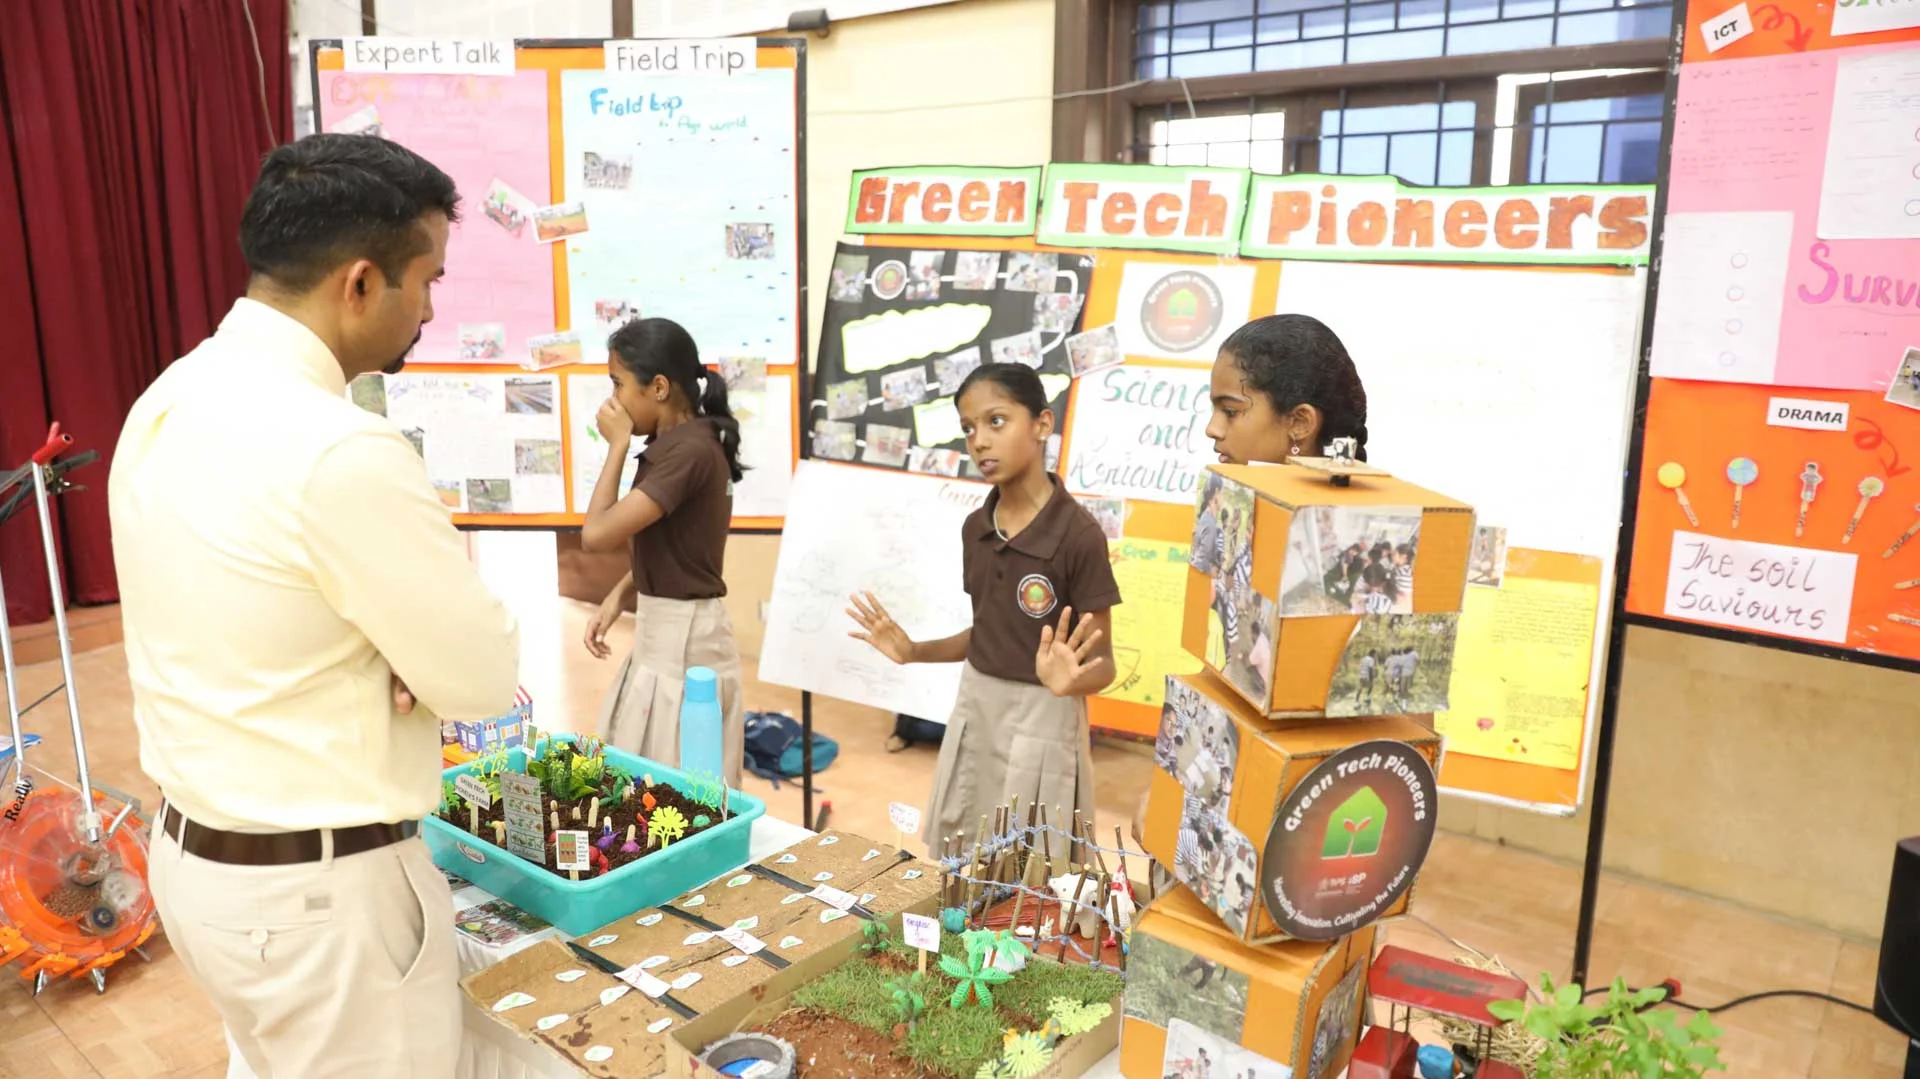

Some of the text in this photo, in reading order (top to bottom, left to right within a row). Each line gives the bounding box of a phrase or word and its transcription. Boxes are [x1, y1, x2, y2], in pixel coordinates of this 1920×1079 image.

[1713, 20, 1738, 40] ICT
[355, 40, 500, 70] Expert Talk
[617, 45, 744, 76] Field Trip
[855, 176, 1649, 250] Green Tech Pioneers
[1797, 242, 1920, 308] SURV
[1102, 368, 1212, 414] Scienc
[1138, 414, 1198, 454] and
[1778, 407, 1844, 425] DRAMA
[1681, 541, 1735, 578] The
[1676, 578, 1827, 631] Saviours
[4, 779, 34, 822] Really
[1284, 752, 1426, 832] Green Tech Pioneers
[1334, 902, 1377, 927] Cultivating
[1375, 891, 1389, 905] the
